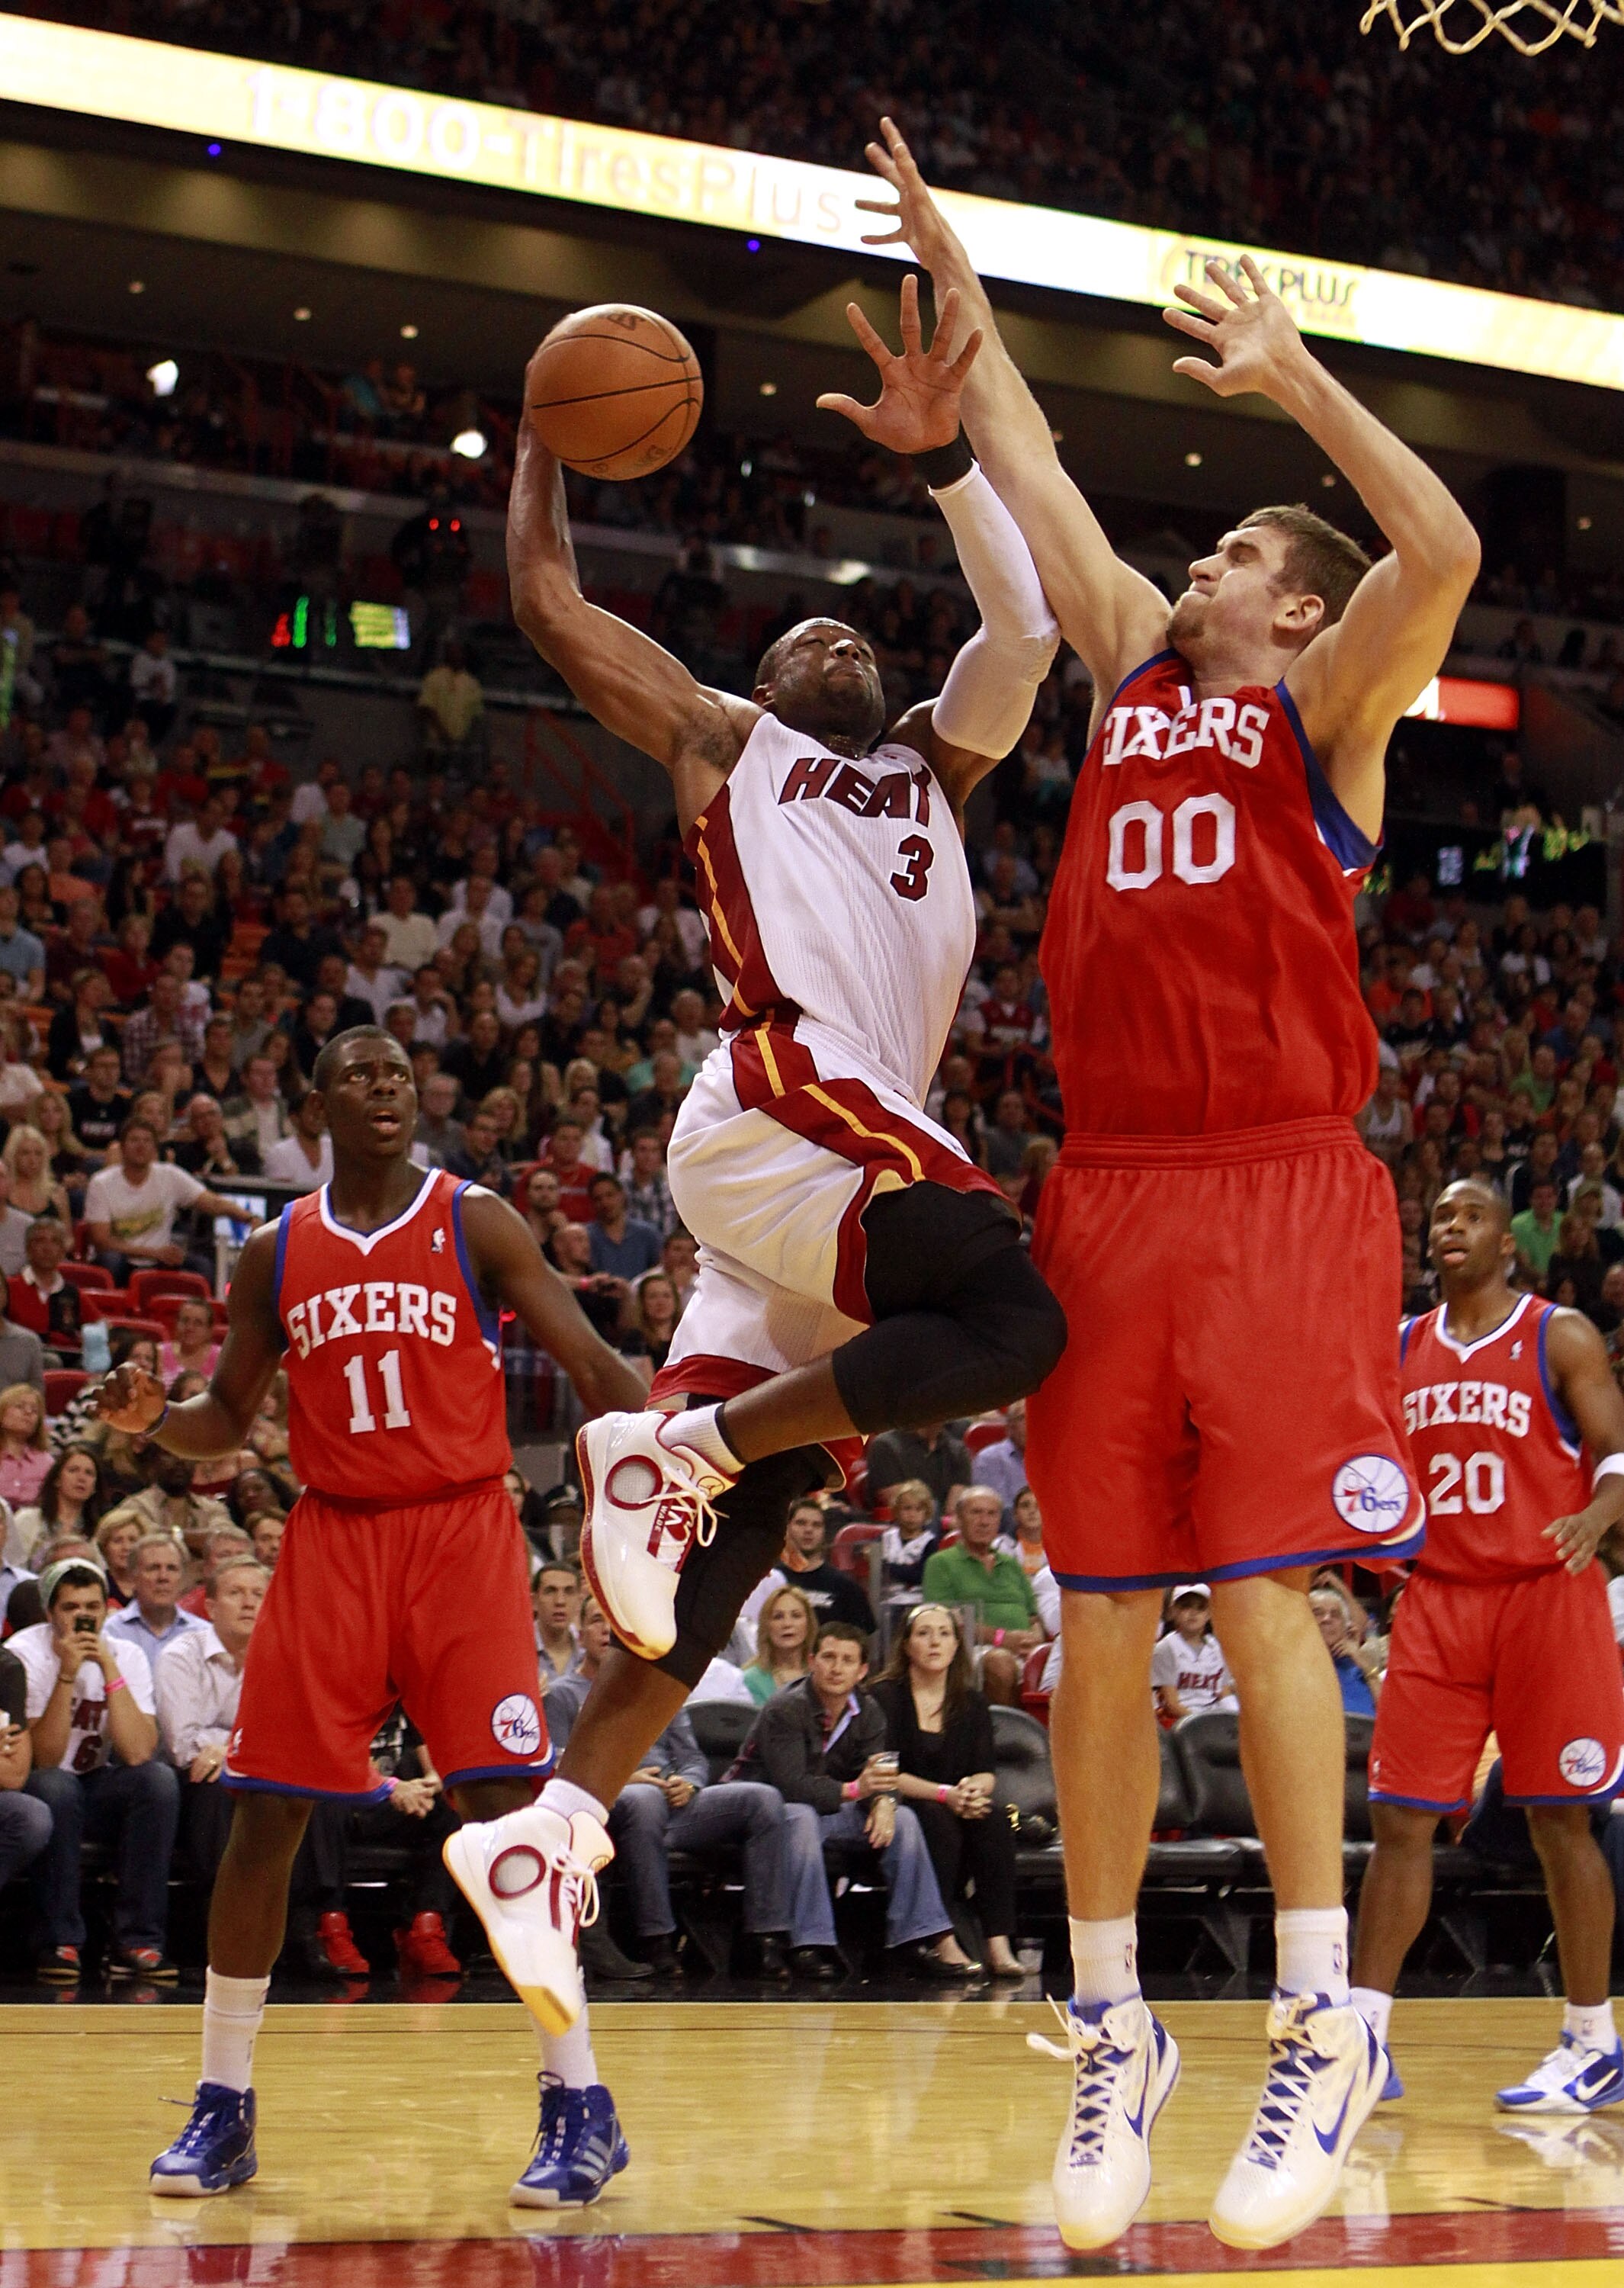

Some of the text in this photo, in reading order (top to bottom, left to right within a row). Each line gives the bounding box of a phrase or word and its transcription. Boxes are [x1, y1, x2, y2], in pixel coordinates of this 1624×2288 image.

[1279, 268, 1356, 307] PLUS
[1102, 697, 1270, 770] IXERS
[778, 757, 932, 828] HEAT
[890, 833, 935, 903] 3
[1106, 792, 1236, 892] 00
[286, 1281, 457, 1361] SIXERS
[343, 1349, 412, 1435] 11
[1402, 1380, 1533, 1438] SIXERS
[1427, 1451, 1506, 1516] 20
[72, 1735, 103, 1771] 6
